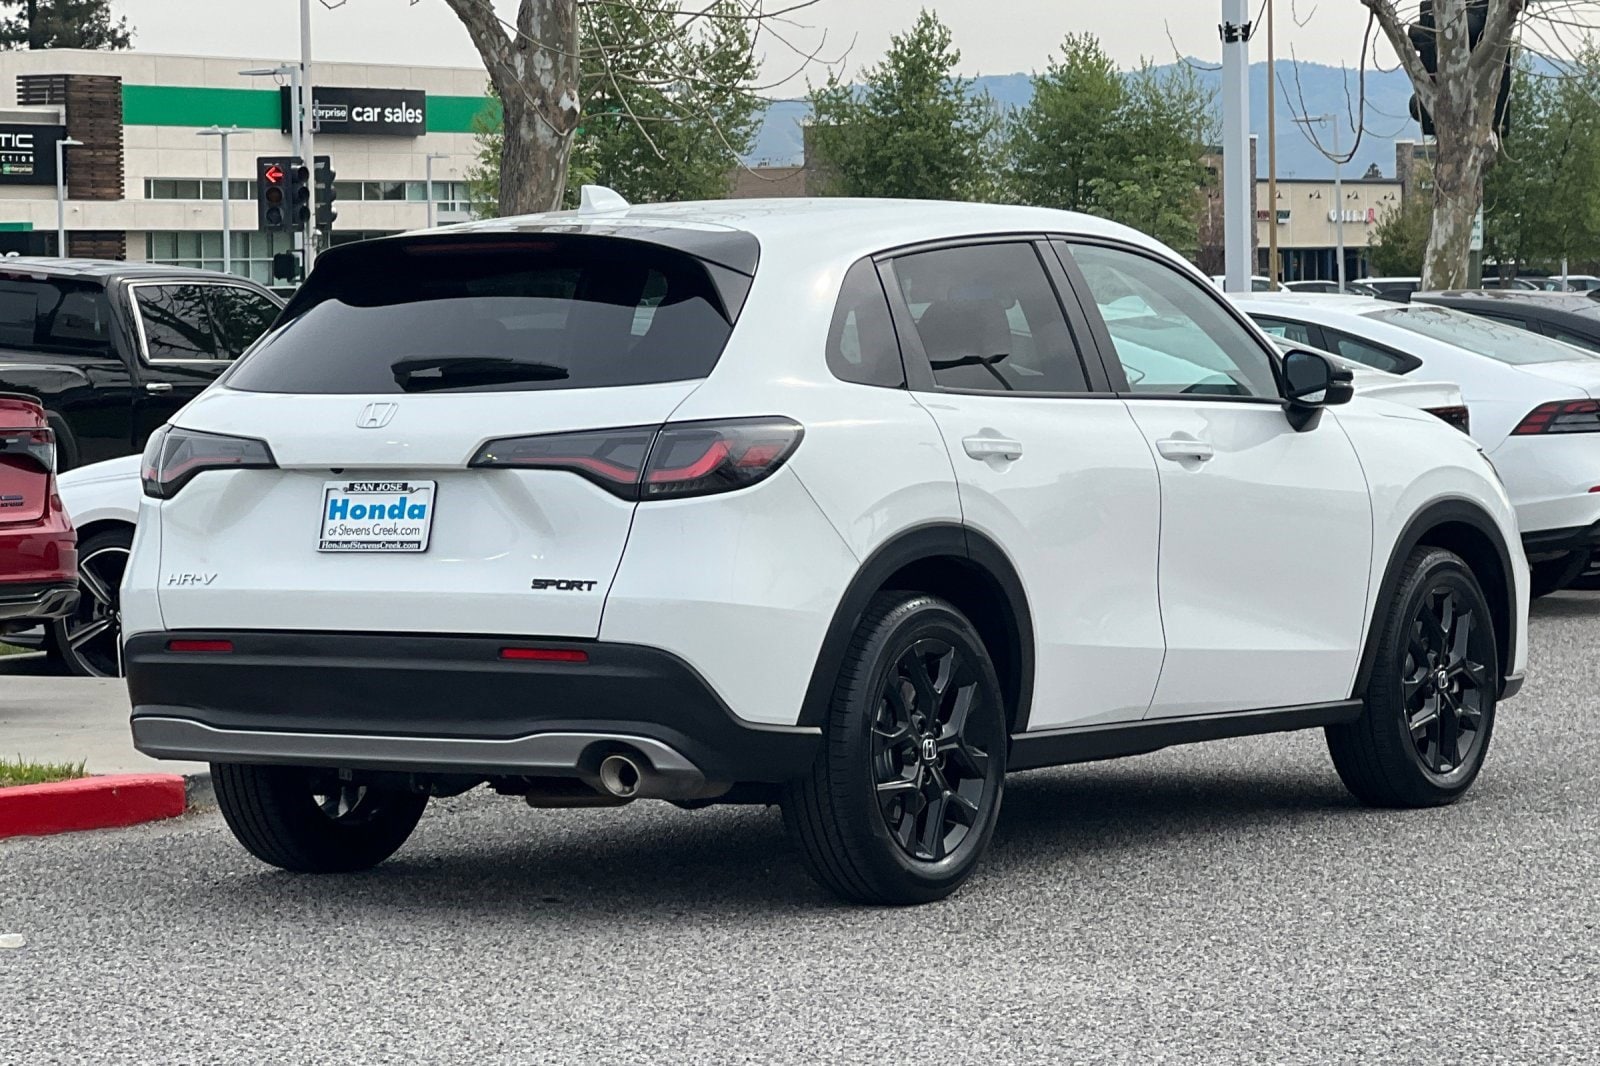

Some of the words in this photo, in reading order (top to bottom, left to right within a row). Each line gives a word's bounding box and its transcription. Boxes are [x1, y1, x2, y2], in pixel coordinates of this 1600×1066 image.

[308, 108, 347, 119] terprise
[352, 107, 381, 122] car
[384, 102, 423, 123] sales
[328, 497, 427, 520] Honda
[328, 526, 338, 536] of
[338, 524, 371, 536] Stevens
[372, 522, 420, 536] Creek.com
[321, 541, 419, 549] HondaofStevensCreek.com
[167, 573, 218, 586] HR-V
[531, 579, 598, 591] SPORT
